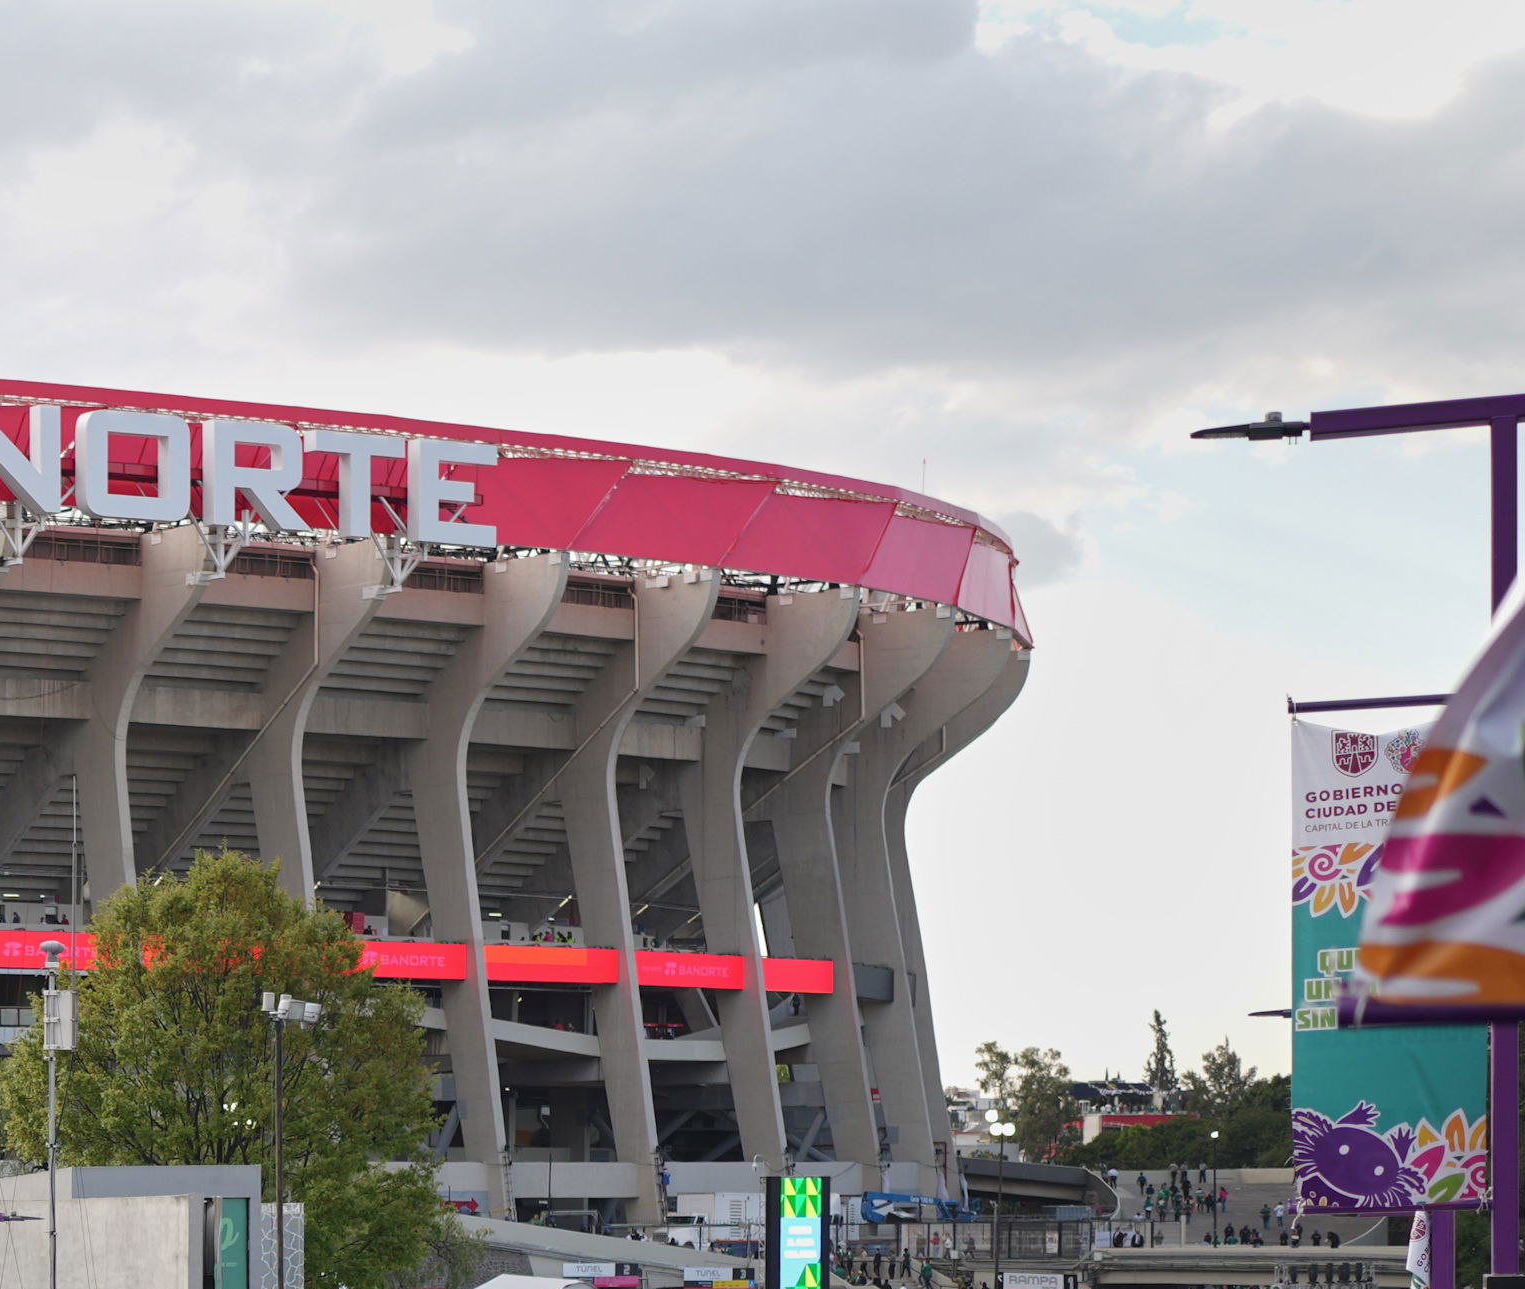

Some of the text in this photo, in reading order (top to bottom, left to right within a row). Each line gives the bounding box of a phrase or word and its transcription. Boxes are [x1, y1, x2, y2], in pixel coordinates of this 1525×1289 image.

[1305, 783, 1404, 803] GOBIERNO
[1305, 801, 1397, 818] CIUDAD DE
[1305, 818, 1389, 833] CAPITAL DE LA TR
[678, 965, 729, 978] BANORTE
[1295, 1006, 1339, 1031] SIN
[623, 1264, 631, 1275] 2
[739, 1269, 747, 1280] 3
[1008, 1275, 1058, 1286] RAMPA
